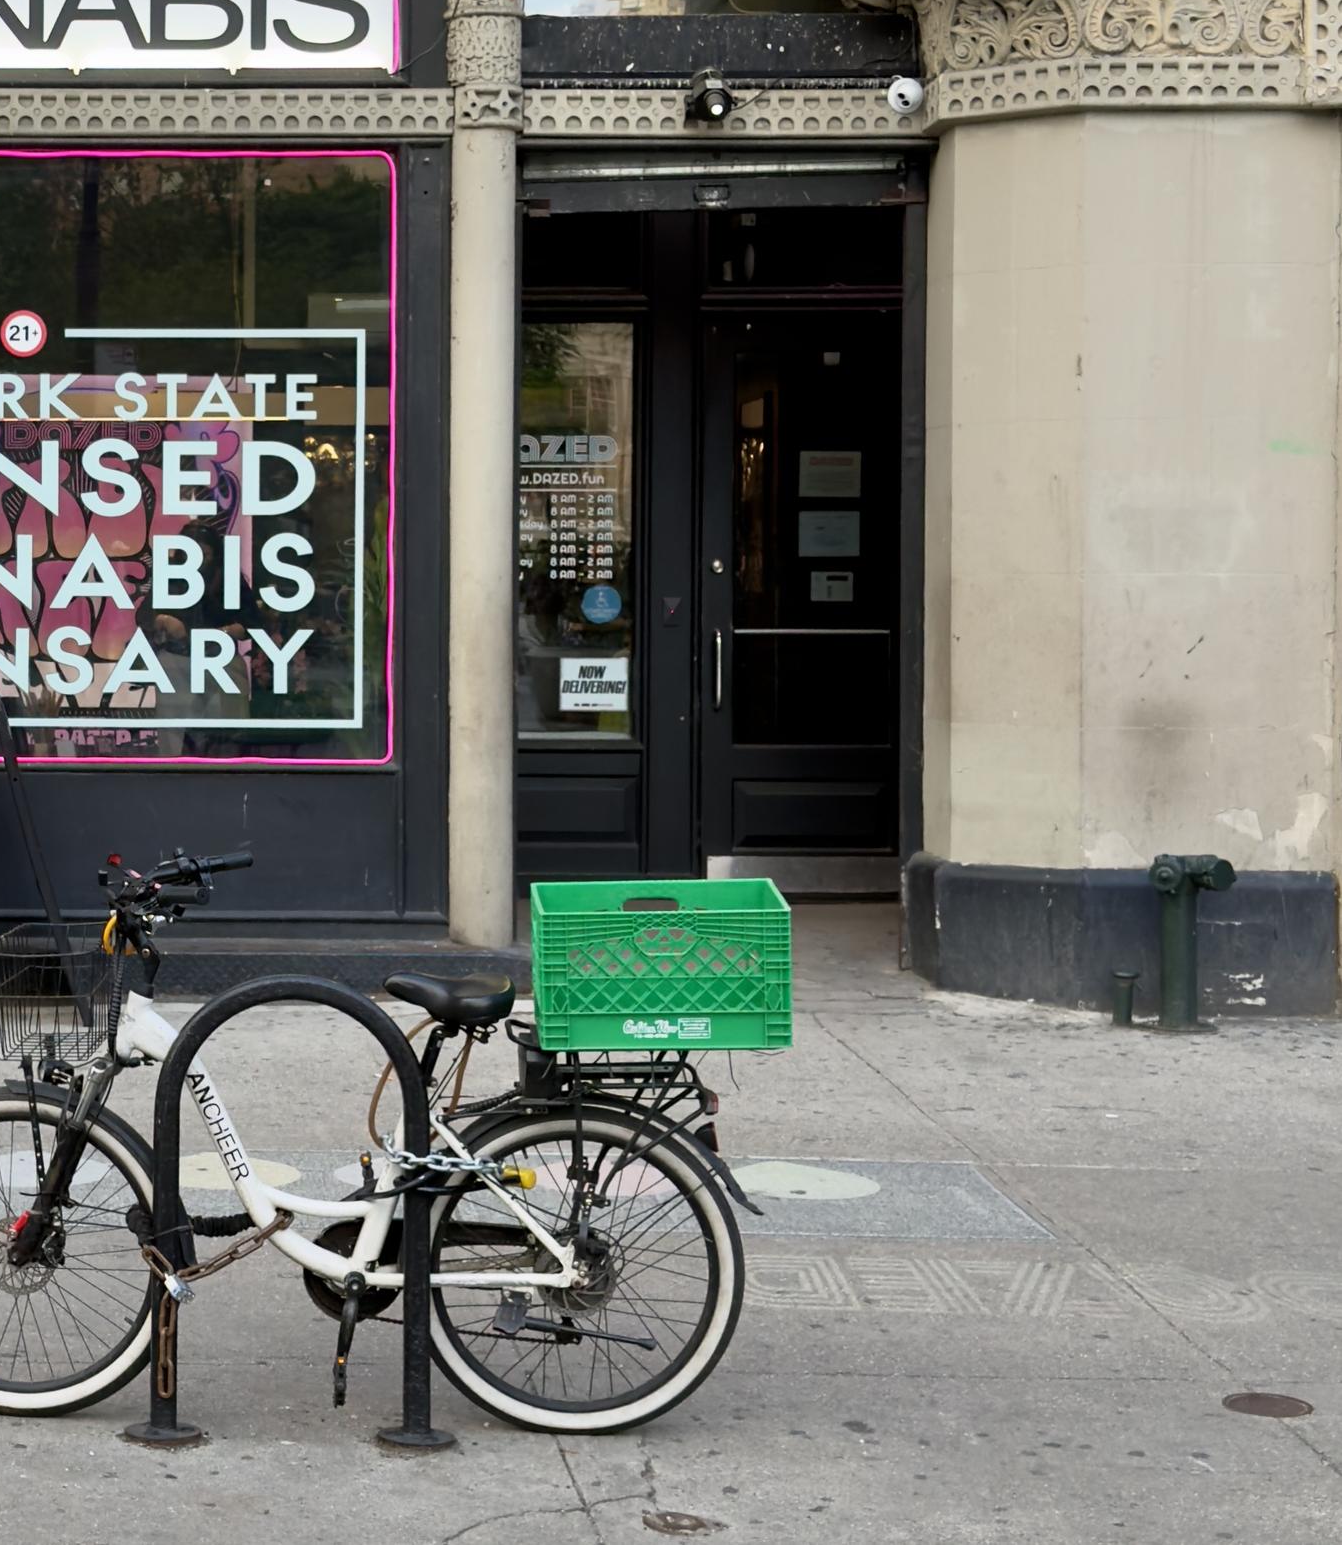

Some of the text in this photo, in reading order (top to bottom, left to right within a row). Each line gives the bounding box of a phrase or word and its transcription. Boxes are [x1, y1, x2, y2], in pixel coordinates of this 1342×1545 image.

[8, 324, 39, 342] 21+
[113, 371, 319, 422] STATE
[550, 495, 558, 503] 8
[560, 495, 576, 503] AM
[588, 495, 594, 503] 2
[597, 495, 614, 503] AM
[550, 507, 557, 516] 8
[560, 507, 576, 516] AM
[587, 507, 594, 516] 2
[597, 507, 613, 516] AM
[550, 520, 557, 528] 8
[560, 520, 576, 528] AM
[587, 520, 594, 528] 2
[597, 520, 613, 528] AM
[550, 533, 557, 541] 8
[560, 533, 576, 541] AM
[587, 533, 594, 541] 2
[597, 533, 613, 541] AM
[550, 545, 557, 553] 8
[560, 545, 576, 553] AM
[587, 545, 594, 553] 2
[597, 545, 613, 553] AM
[549, 557, 557, 566] 8
[559, 557, 576, 566] AM
[587, 557, 594, 566] 2
[596, 557, 613, 566] AM
[549, 570, 557, 579] 8
[559, 570, 576, 579] AM
[587, 570, 594, 579] 2
[596, 570, 613, 579] AM
[578, 665, 607, 679] NOW
[562, 680, 627, 694] DELIVERING!
[186, 1072, 250, 1182] ANCHEER
